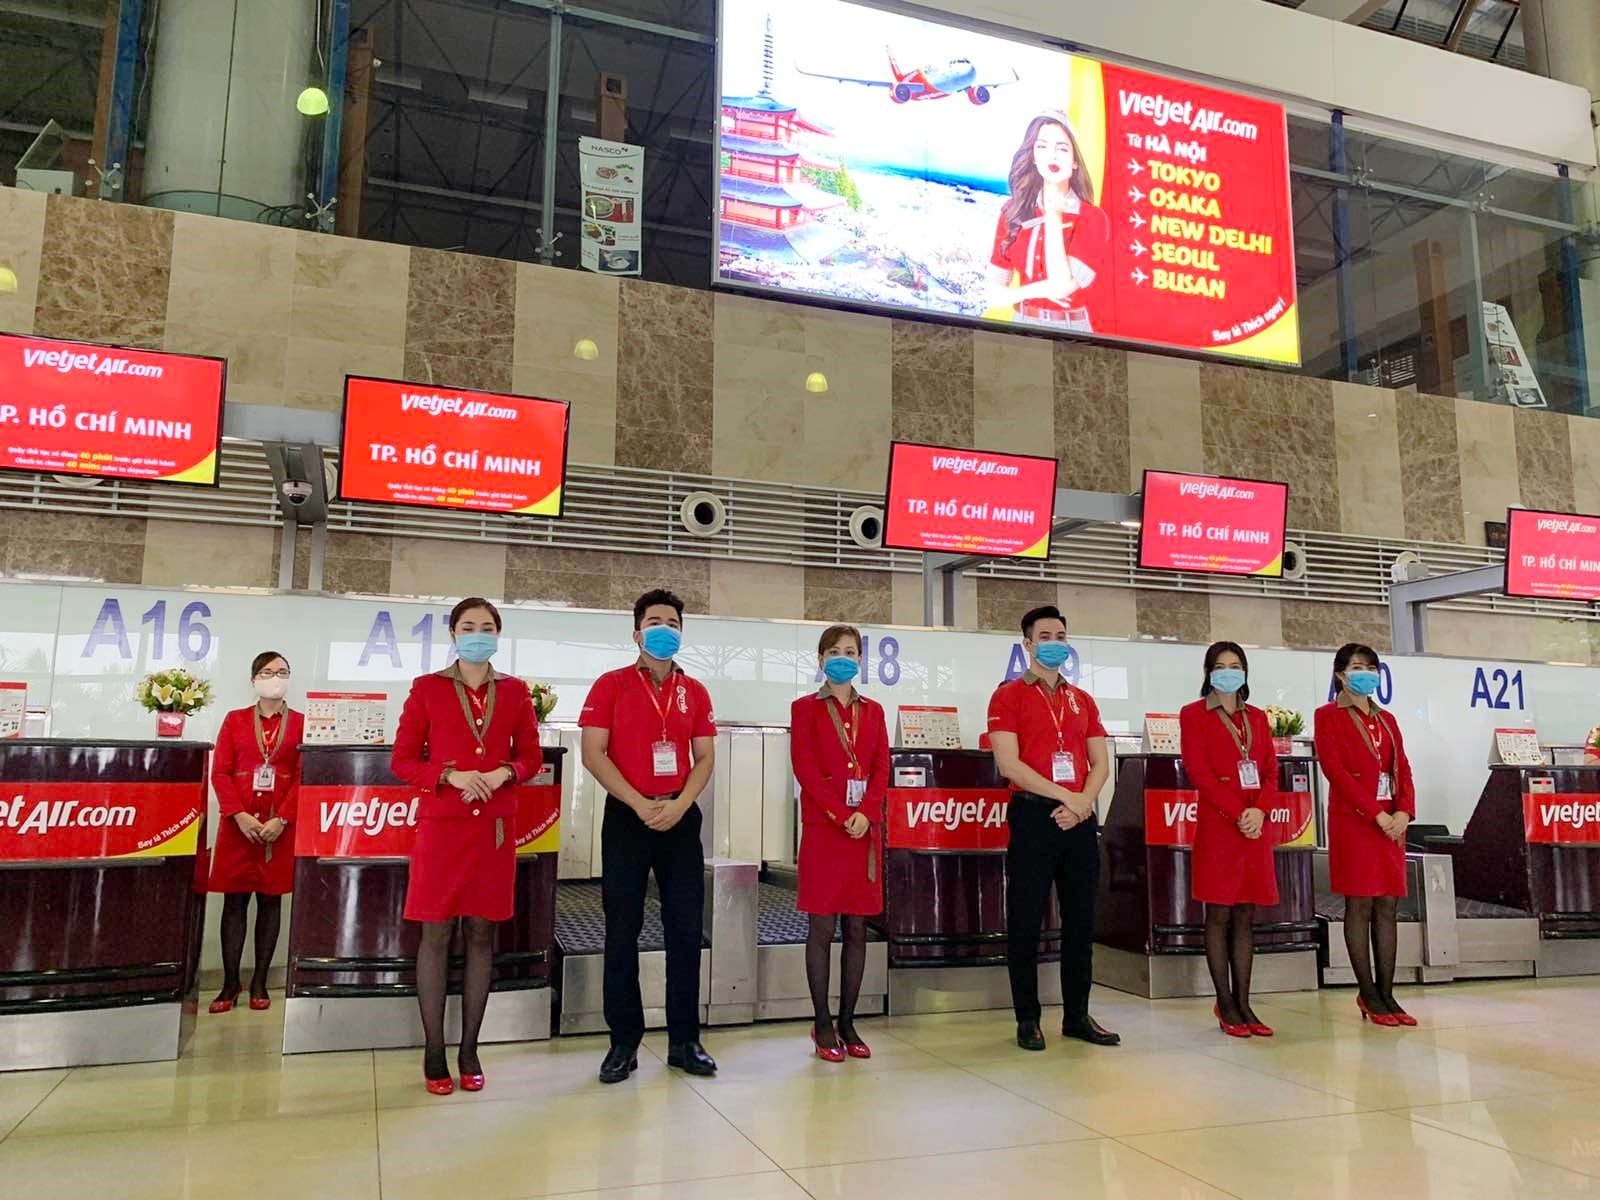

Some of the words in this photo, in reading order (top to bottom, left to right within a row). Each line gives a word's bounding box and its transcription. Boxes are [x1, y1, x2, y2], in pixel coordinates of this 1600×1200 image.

[1145, 134, 1171, 154] HÀ
[1174, 141, 1206, 164] NỘI
[1148, 160, 1221, 192] TOKYO
[1149, 188, 1221, 218] OSAKA
[1151, 214, 1205, 241] NEW
[1208, 225, 1272, 254] DELHI
[1151, 241, 1220, 271] SEOUL
[1152, 268, 1226, 299] BUSAN
[1212, 329, 1231, 341] Bay
[29, 403, 66, 428] HỒ
[75, 411, 118, 432] CHÍ
[124, 417, 192, 440] MINH
[80, 451, 91, 459] 40
[369, 443, 398, 462] TP.
[405, 444, 437, 466] HỒ
[443, 450, 479, 470] CHÍ
[484, 455, 541, 476] MINH
[907, 499, 929, 515] TP.
[933, 498, 958, 517] HỒ
[962, 503, 988, 520] CHÍ
[992, 507, 1035, 525] MINH
[1158, 522, 1178, 537] TP.
[1182, 521, 1203, 539] HỒ
[1206, 525, 1230, 541] CHÍ
[1233, 528, 1270, 545] MINH
[1521, 555, 1536, 568] TP.
[1559, 556, 1577, 571] CHÍ
[81, 598, 212, 662] A16
[1470, 667, 1525, 710] A21
[320, 796, 420, 836] Vietjet
[137, 839, 153, 849] Bay
